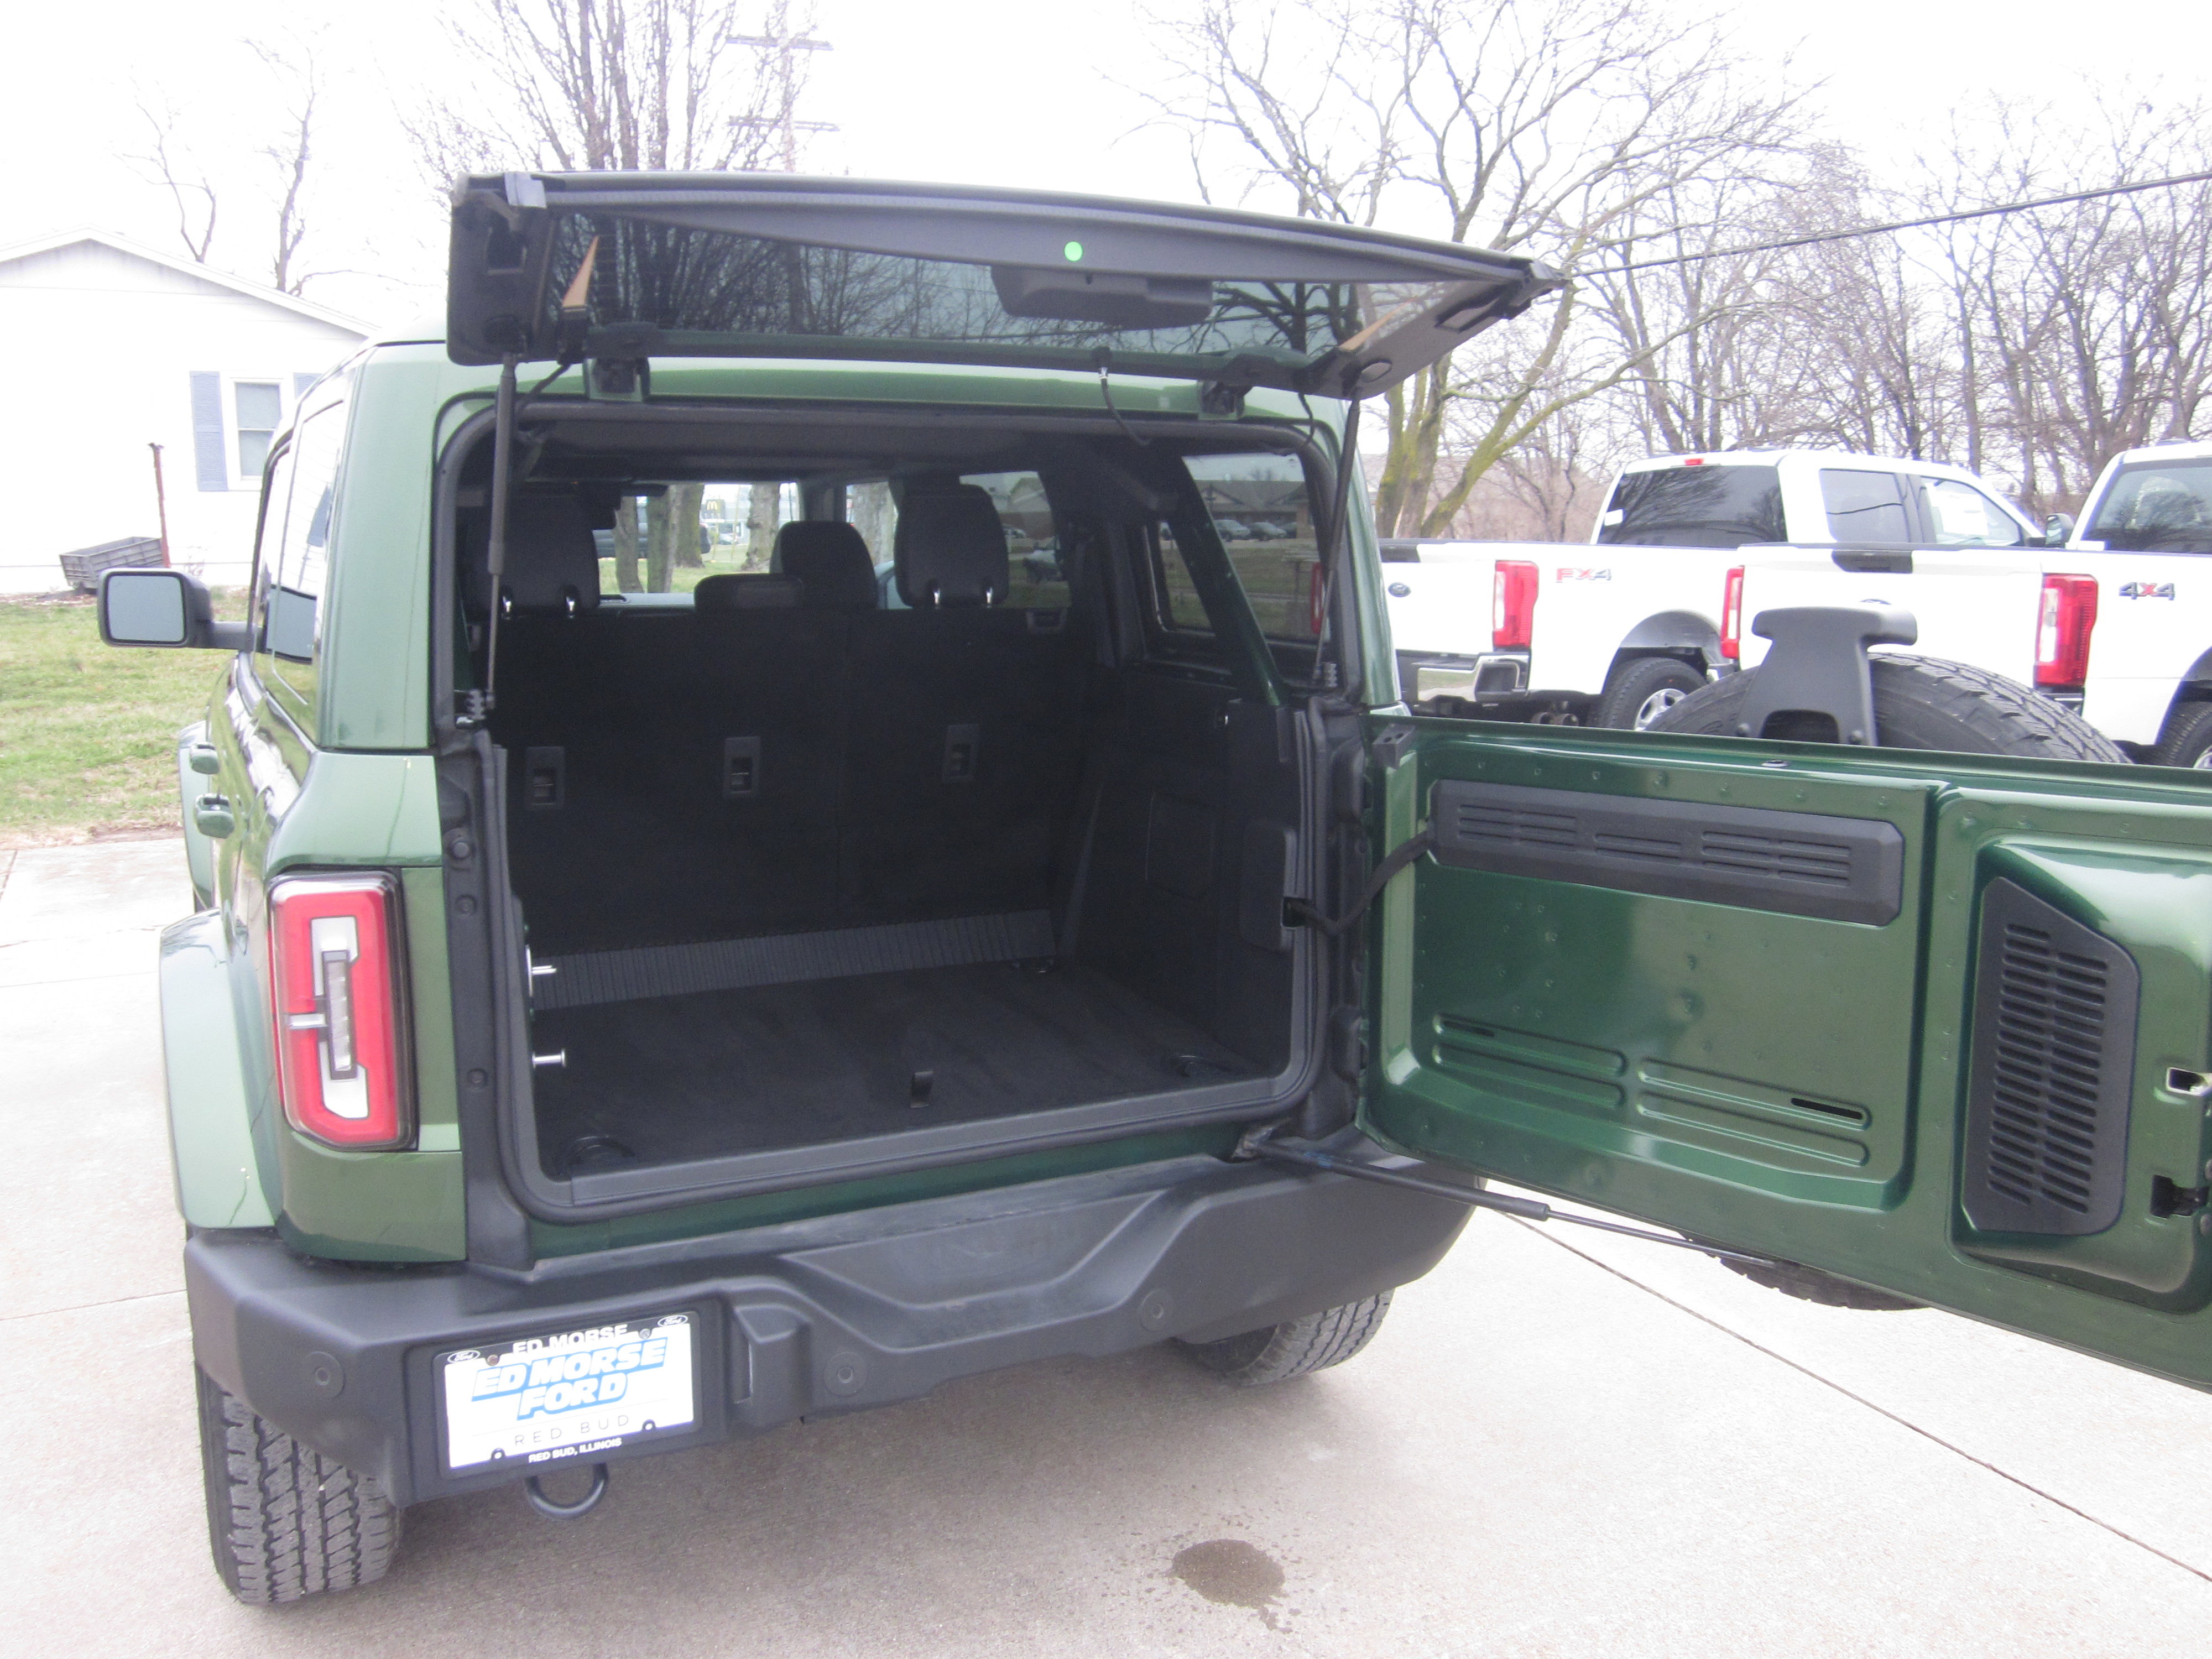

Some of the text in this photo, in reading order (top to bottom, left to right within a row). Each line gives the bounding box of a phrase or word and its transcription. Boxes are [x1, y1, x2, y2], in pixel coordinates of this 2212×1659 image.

[1556, 568, 1611, 583] FX4
[512, 1324, 628, 1355] ED MORSE
[472, 1338, 667, 1399] ED MORSE
[518, 1373, 627, 1418] FORD
[514, 1415, 629, 1446] RED BUD
[528, 1437, 623, 1464] RED BUD, ILLINOIS
